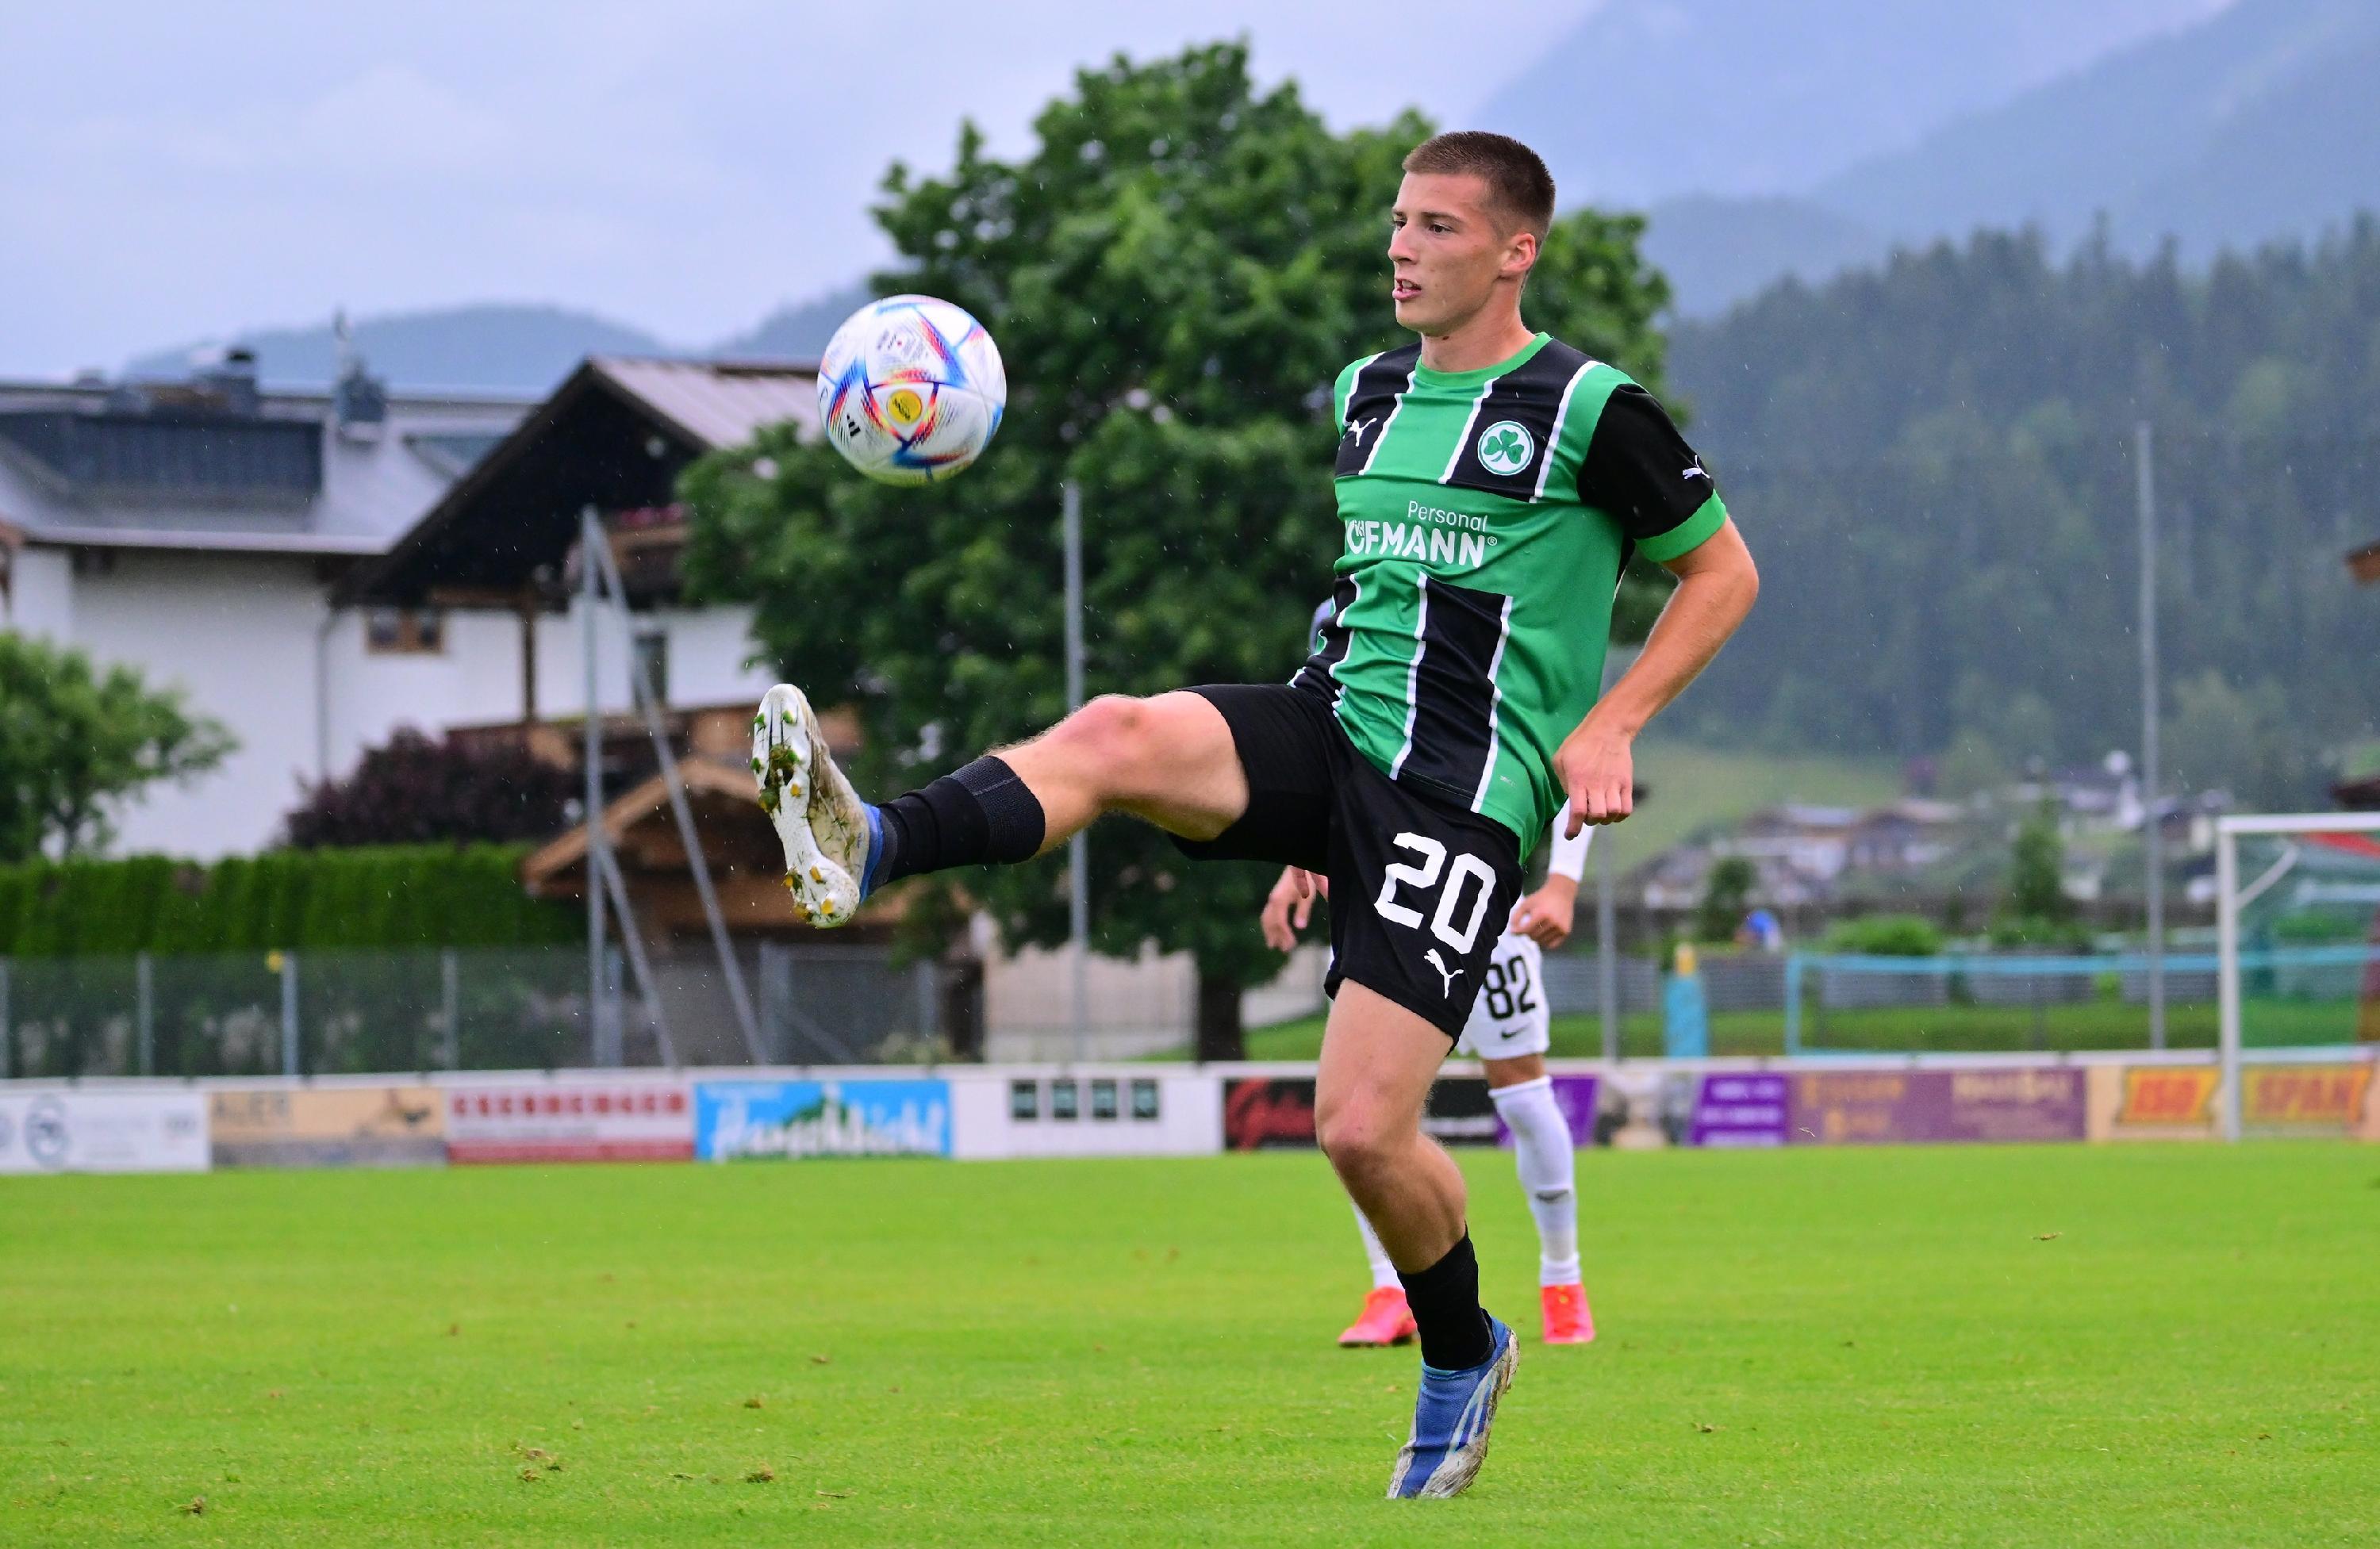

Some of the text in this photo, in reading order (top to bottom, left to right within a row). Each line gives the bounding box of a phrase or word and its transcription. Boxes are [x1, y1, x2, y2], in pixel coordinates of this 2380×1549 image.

[1407, 500, 1488, 532] Personal
[1373, 832, 1496, 954] 20
[1484, 955, 1535, 1020] 82
